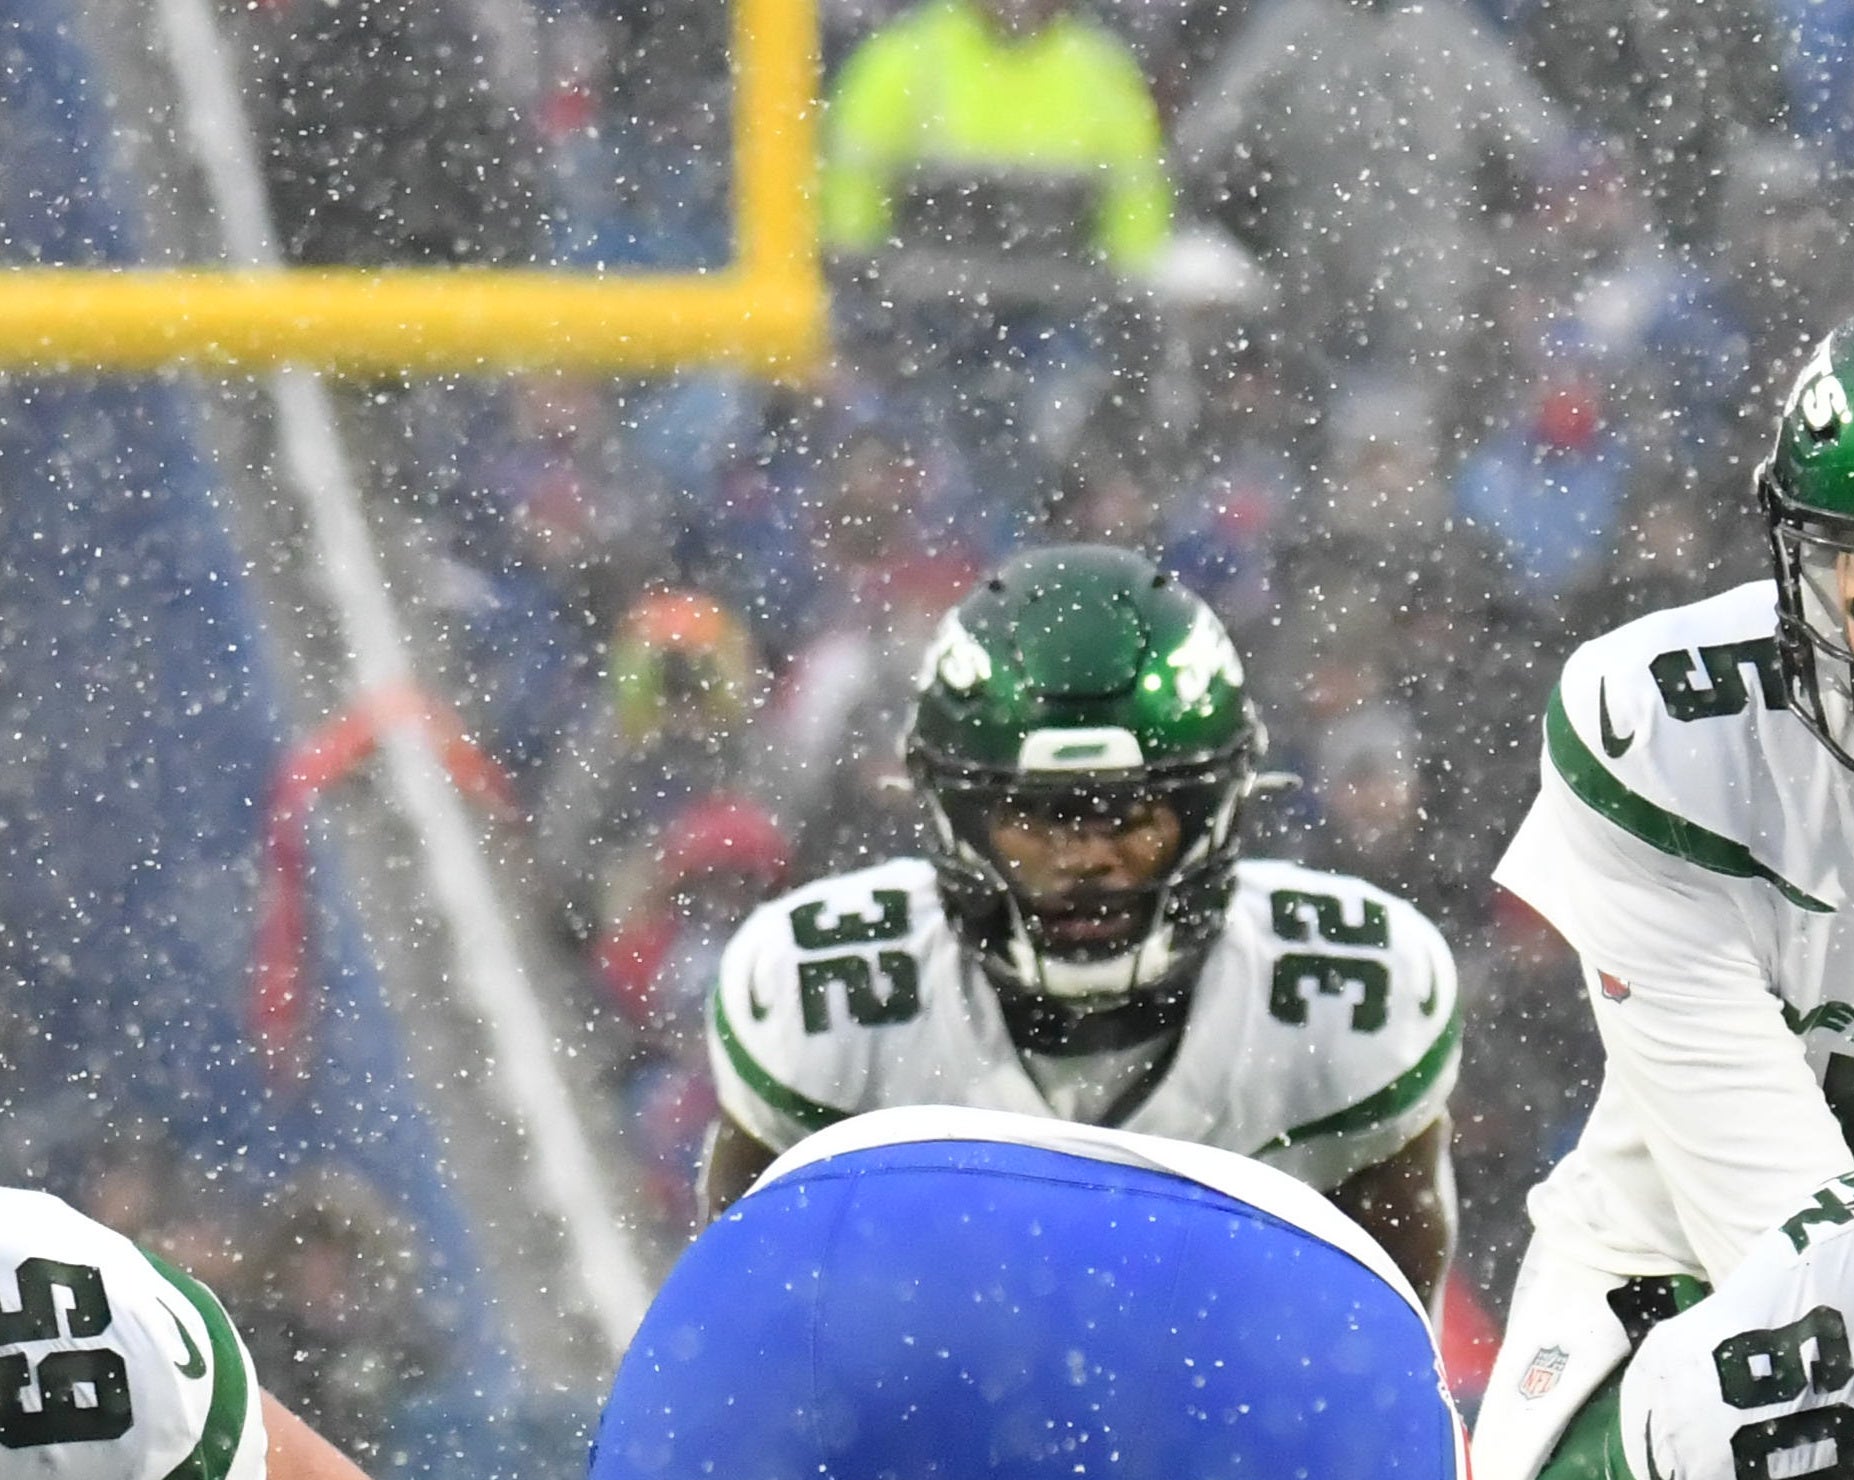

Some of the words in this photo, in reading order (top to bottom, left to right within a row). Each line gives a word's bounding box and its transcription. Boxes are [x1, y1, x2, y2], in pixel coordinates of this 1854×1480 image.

[1649, 636, 1790, 717] 5
[790, 889, 920, 1034] 32
[1270, 889, 1392, 1032] 32
[0, 1257, 134, 1449] 65
